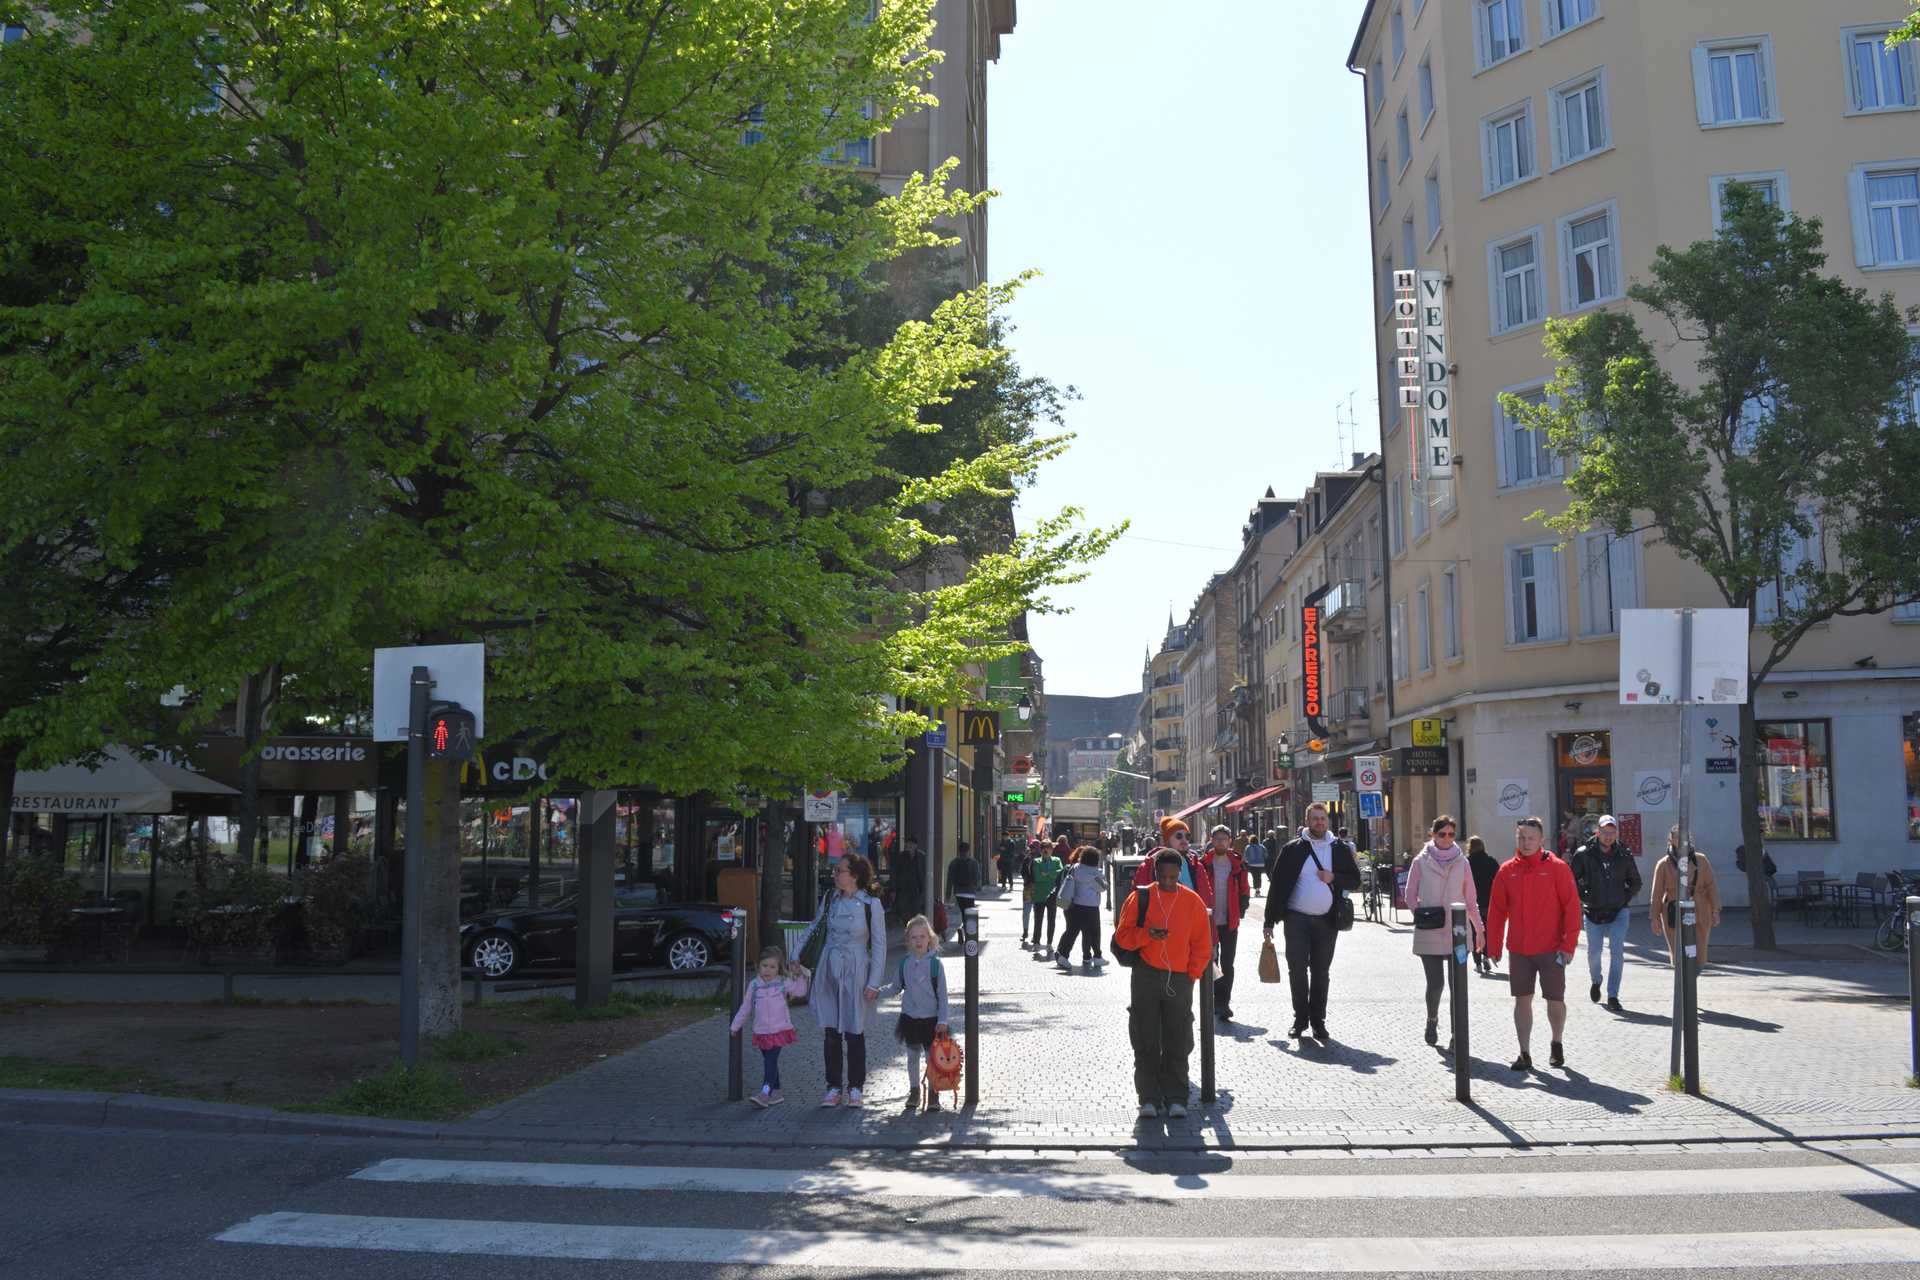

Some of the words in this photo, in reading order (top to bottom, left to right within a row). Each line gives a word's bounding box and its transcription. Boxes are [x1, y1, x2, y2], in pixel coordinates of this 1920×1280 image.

[1399, 273, 1416, 404] HOTEL
[1423, 279, 1449, 467] VENDOME
[1304, 607, 1319, 715] EXPRESSO
[11, 796, 121, 810] RESTAURANT
